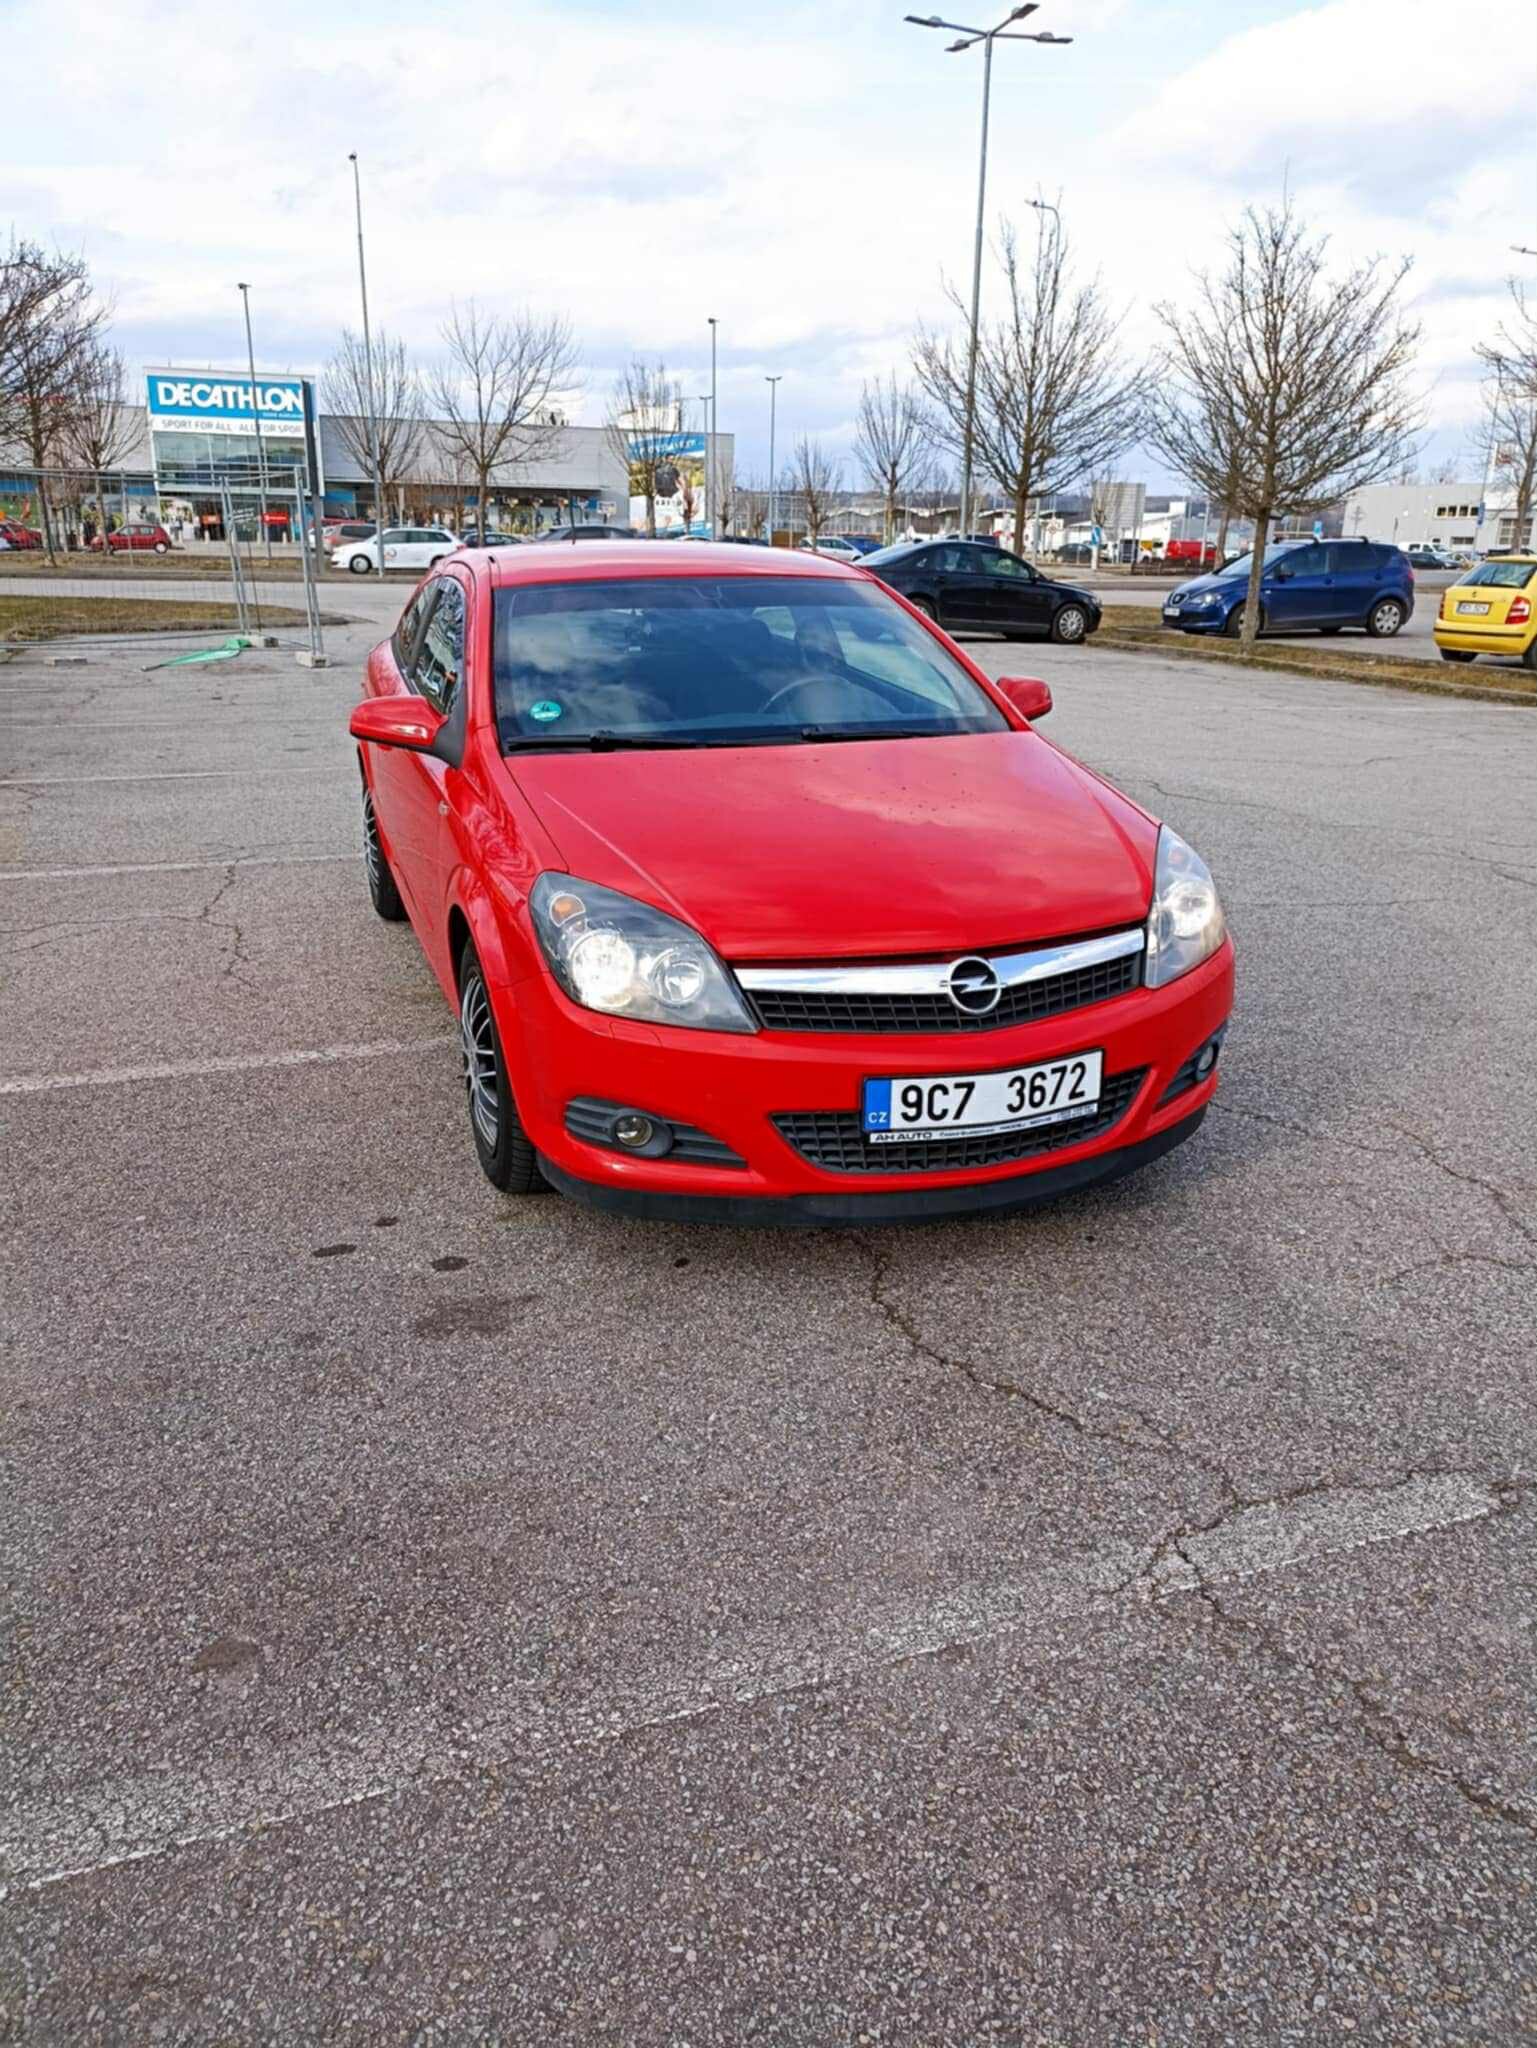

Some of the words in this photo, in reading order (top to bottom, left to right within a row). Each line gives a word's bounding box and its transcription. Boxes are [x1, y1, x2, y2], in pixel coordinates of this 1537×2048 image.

[157, 381, 304, 412] DECATHLON
[162, 418, 192, 429] SPORT
[278, 425, 303, 434] SPOR
[900, 1082, 976, 1123] 9C7
[1006, 1061, 1087, 1114] 3672
[868, 1112, 888, 1124] CZ
[896, 1131, 933, 1141] AUTO
